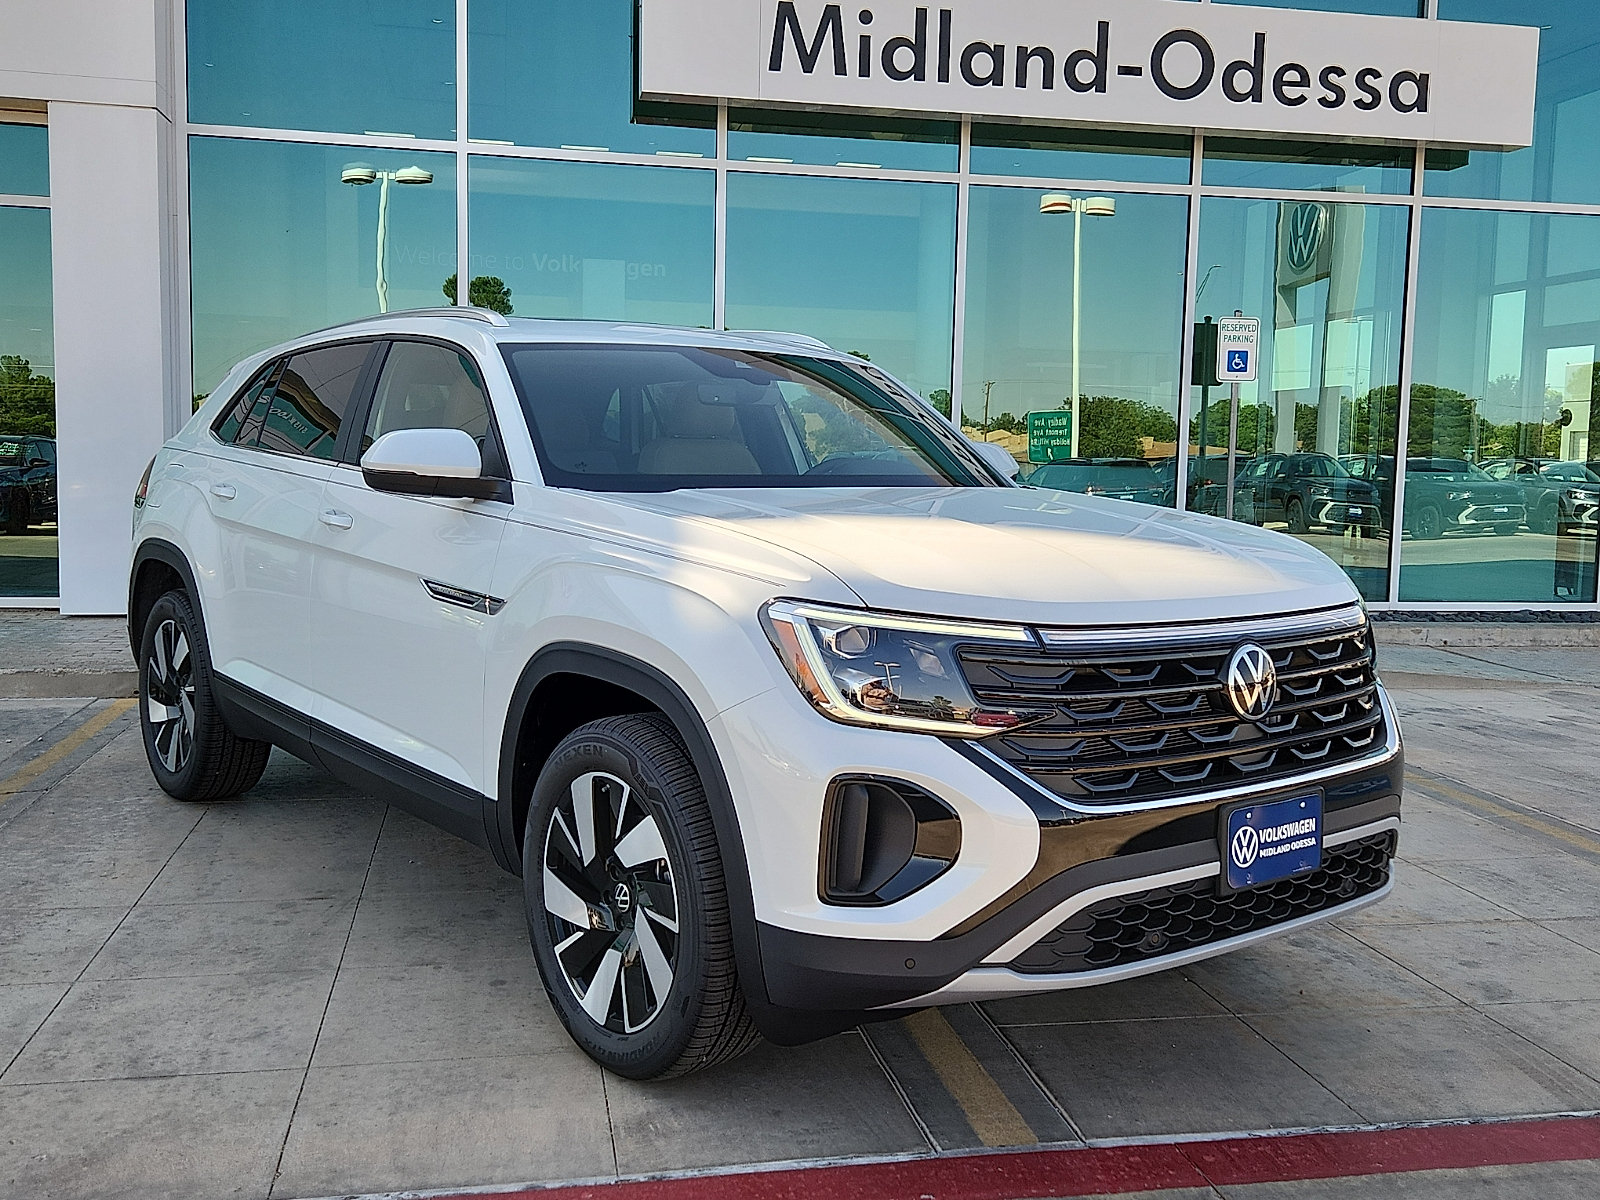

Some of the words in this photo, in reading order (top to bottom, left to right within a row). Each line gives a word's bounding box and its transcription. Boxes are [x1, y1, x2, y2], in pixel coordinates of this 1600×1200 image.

[768, 1, 1430, 113] Midland-Odessa
[505, 252, 525, 272] to
[532, 252, 667, 281] Volkgen
[1222, 323, 1257, 332] RESERVED
[1223, 334, 1254, 343] PARKING
[1228, 643, 1277, 720] VW
[555, 743, 604, 769] NEXEN
[1258, 817, 1317, 844] VOLKSWAGEN
[1231, 825, 1259, 869] VW
[1259, 843, 1291, 859] MIDLAND
[1290, 837, 1317, 851] ODESSA
